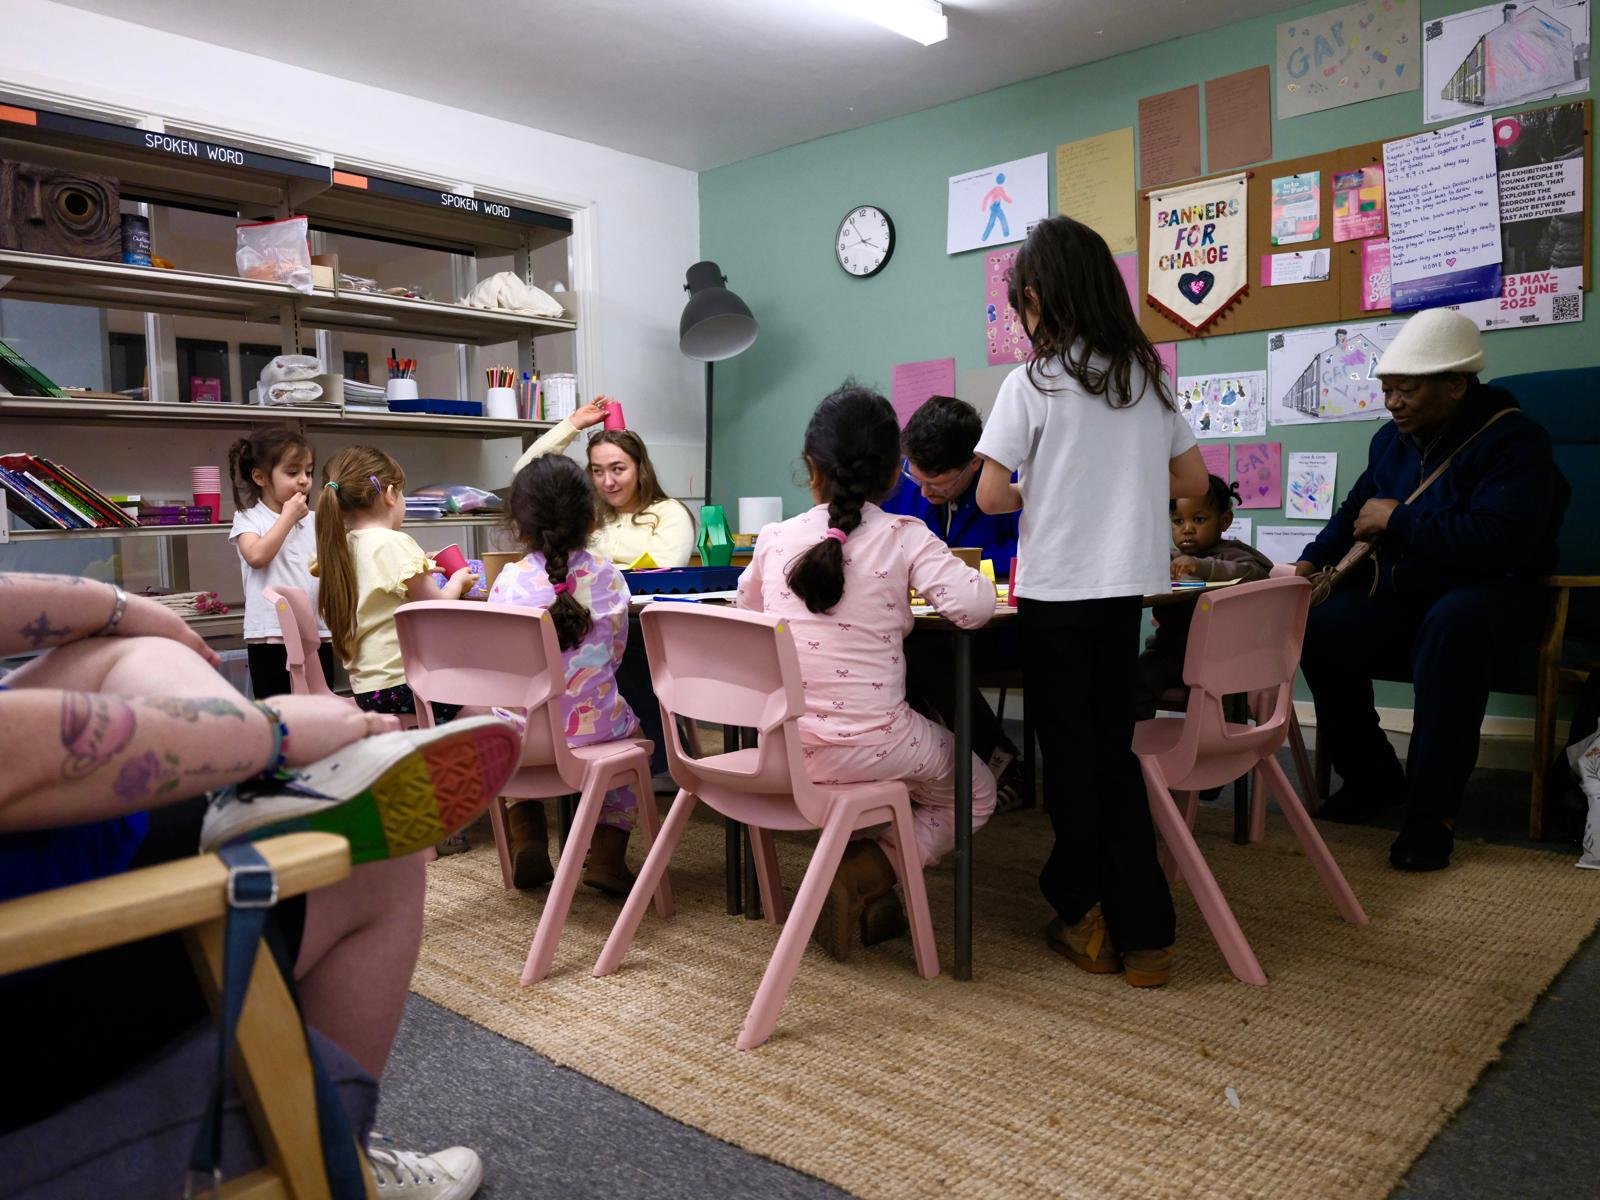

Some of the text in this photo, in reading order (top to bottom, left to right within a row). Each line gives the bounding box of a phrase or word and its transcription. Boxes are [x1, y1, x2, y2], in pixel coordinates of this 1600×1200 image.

[145, 134, 244, 165] SPOKEN WORD
[1413, 153, 1434, 161] football
[1512, 165, 1552, 177] EXHIBITION
[1501, 177, 1526, 186] YOUNG
[1527, 172, 1553, 181] PEOPLE
[1501, 182, 1544, 193] DONCASTER,
[1501, 189, 1536, 200] EXPLORES
[441, 194, 510, 218] SPOKEN WORD
[1501, 197, 1535, 207] BEDROOM
[1553, 191, 1576, 199] SPACE
[1158, 199, 1239, 228] BANNERS
[1501, 200, 1566, 214] CAUGHT BETWEEN
[1519, 211, 1534, 219] AND
[1535, 207, 1565, 216] FUTURE.
[1175, 223, 1215, 250] FOR
[1159, 245, 1228, 271] CHANGE
[852, 264, 856, 272] 7
[1502, 277, 1516, 287] 13
[1501, 283, 1558, 298] 10 JUNE
[1500, 297, 1536, 310] 2025
